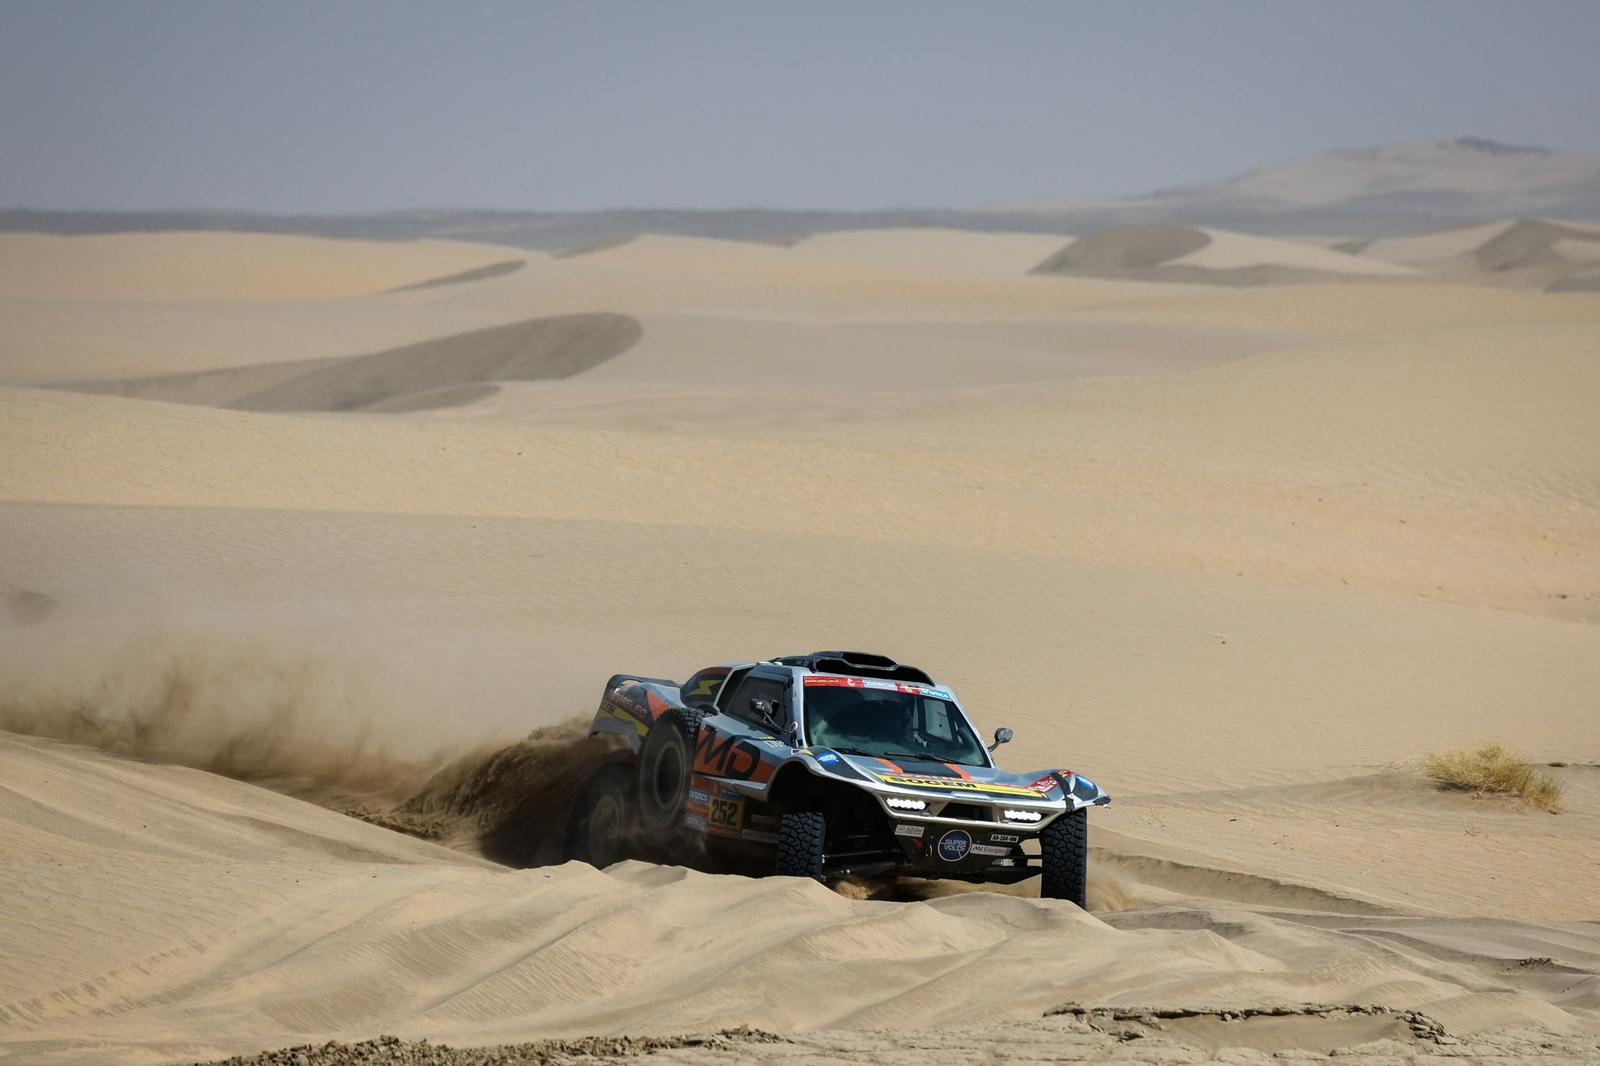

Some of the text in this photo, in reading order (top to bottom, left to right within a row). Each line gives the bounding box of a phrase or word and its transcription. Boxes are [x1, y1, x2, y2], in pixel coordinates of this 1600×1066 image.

[689, 790, 708, 802] aramco
[711, 799, 739, 827] 252
[945, 839, 966, 847] SUPER
[984, 846, 1005, 855] Energies
